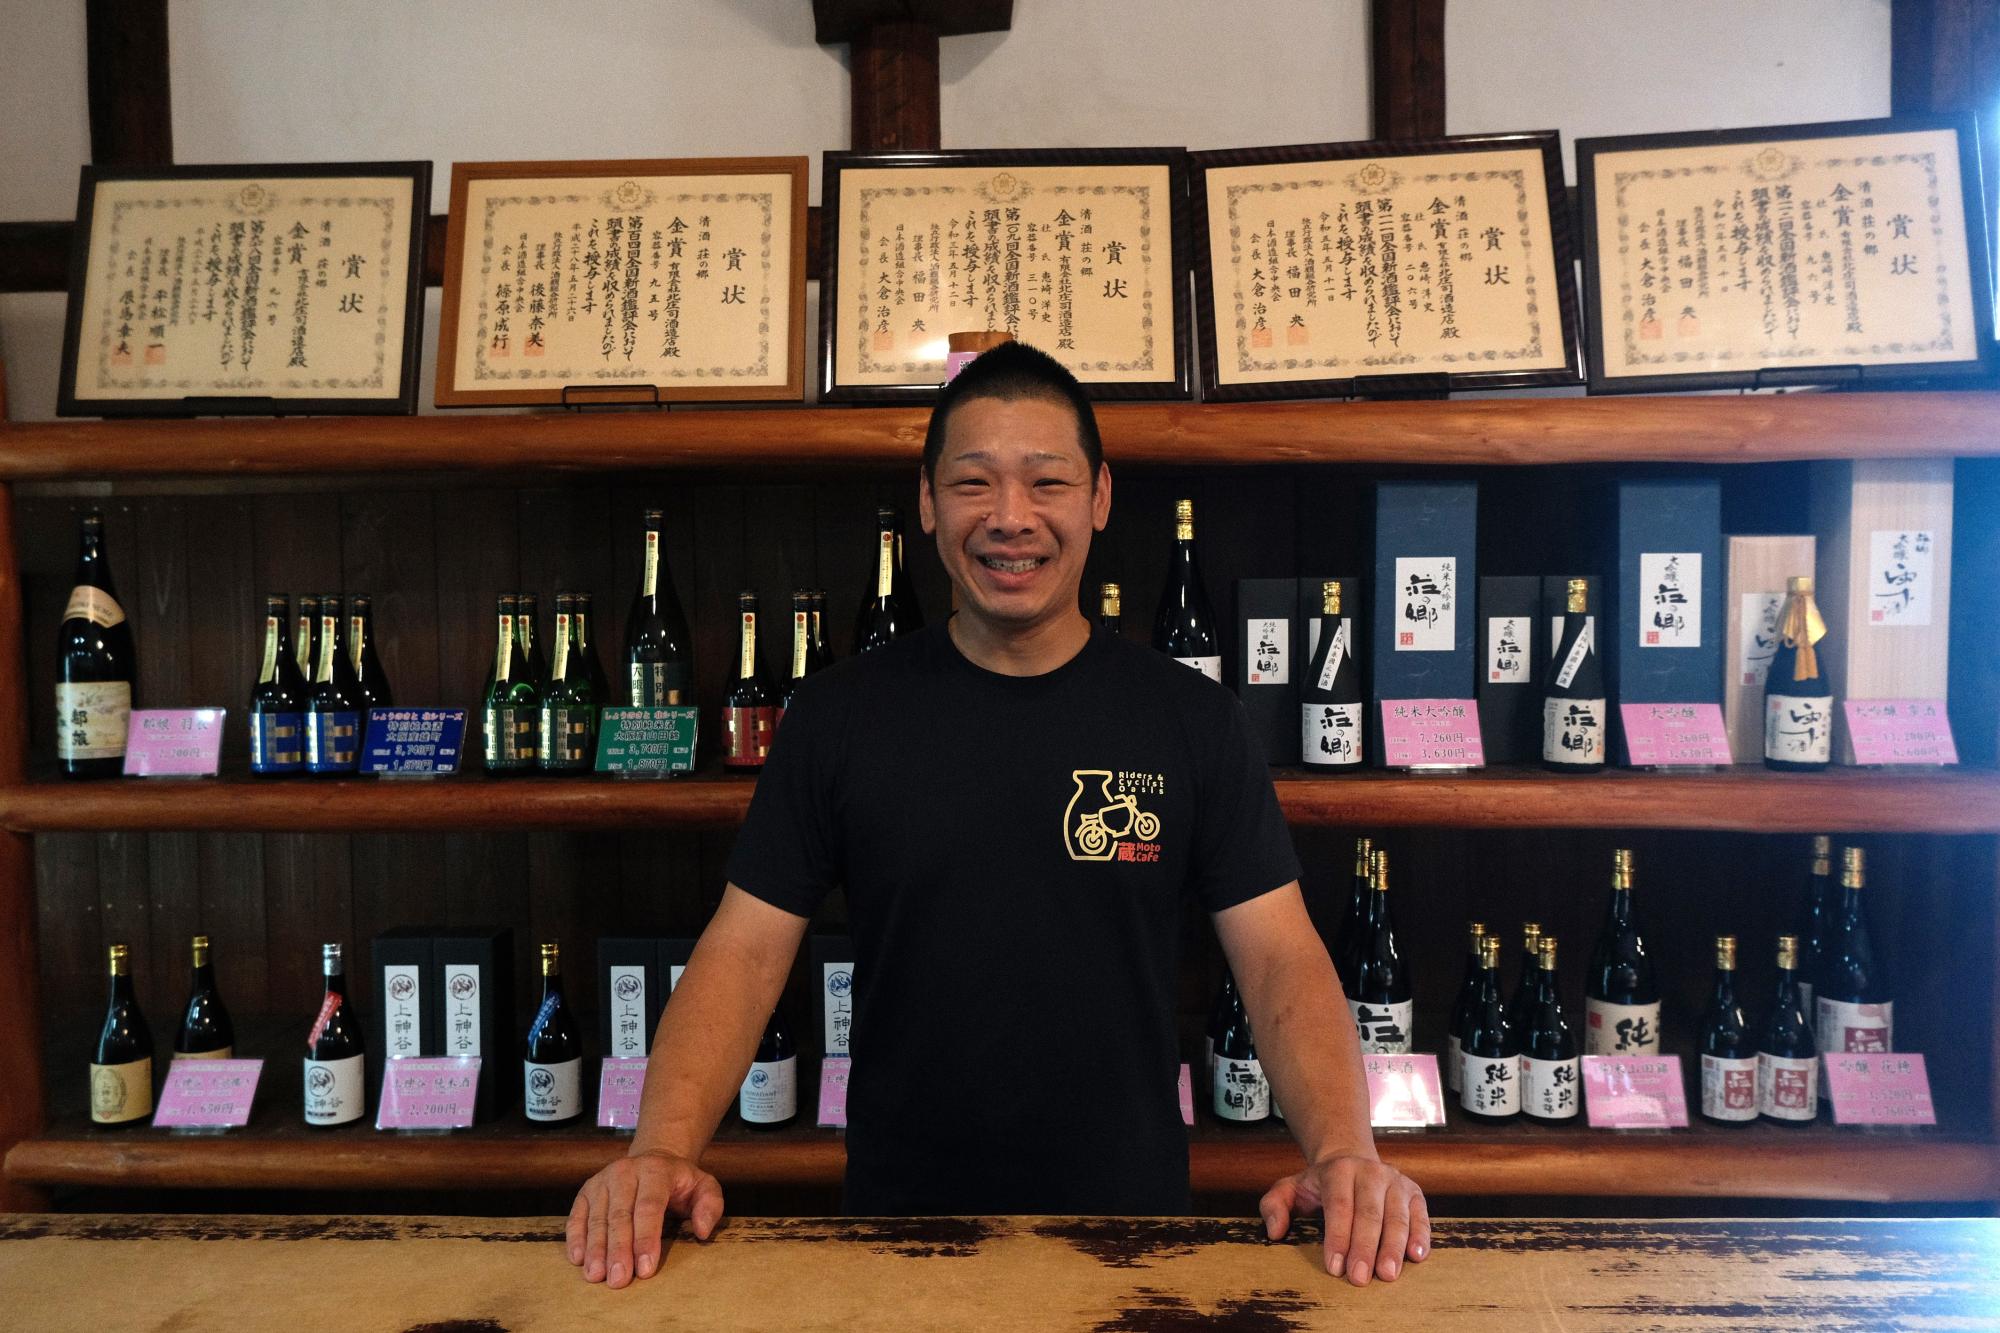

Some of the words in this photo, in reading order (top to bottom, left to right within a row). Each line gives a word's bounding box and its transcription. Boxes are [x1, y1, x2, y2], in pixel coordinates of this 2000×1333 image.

[1080, 208, 1093, 235] 清酒
[1427, 196, 1451, 240] 金賞
[1454, 195, 1468, 222] 清酒
[1830, 182, 1854, 227] 金賞
[288, 222, 310, 265] 金賞
[651, 230, 662, 269] 容器番号
[666, 217, 689, 258] 金賞
[698, 216, 712, 241] 清酒
[879, 236, 890, 263] 会長
[912, 234, 924, 262] 理事長
[1027, 222, 1038, 262] 容器番号
[1053, 209, 1076, 251] 金賞
[1250, 233, 1262, 260] 会長
[1285, 230, 1297, 258] 理事長
[1457, 227, 1473, 263] 荘の郷
[1730, 190, 1752, 291] これを授与します
[1886, 213, 1919, 275] 賞状
[500, 244, 512, 272] 会長
[535, 243, 547, 271] 理事長
[581, 218, 602, 314] これを授与します
[696, 248, 710, 280] 荘の郷
[895, 223, 905, 305] 日本酒造組合中央会
[961, 210, 981, 307] これを授与します
[983, 209, 1001, 333] 頭書の成績を収められまし
[1080, 242, 1093, 278] 荘の郷
[1102, 240, 1128, 299] 賞状
[1266, 220, 1282, 302] 日本酒造組合中央会
[1335, 202, 1357, 302] これを授与します
[1480, 227, 1511, 286] 賞状
[339, 255, 365, 313] 賞状
[601, 218, 624, 362] 頭書の成績を収められましたので
[620, 216, 644, 362] 第百四回全国新酒鑑評会において
[721, 247, 747, 305] 賞状
[1354, 200, 1382, 349] 頭書の成績を収められましたので
[647, 279, 661, 321] 九五号
[1394, 705, 1466, 718] 純米大吟醸
[1420, 733, 1464, 744] 7,260円
[1422, 748, 1466, 759] 3,630円
[1118, 771, 1153, 781] Riders
[1118, 778, 1164, 788] Cyclist
[1118, 785, 1164, 795] Oasis
[1117, 842, 1136, 863] 蔵
[1137, 843, 1161, 852] Moto
[1137, 852, 1160, 862] Cafe
[393, 1003, 412, 1050] 上神谷
[454, 1003, 473, 1050] 上神谷
[619, 1003, 638, 1050] 上神谷
[1485, 1063, 1512, 1107] 純米
[1553, 1064, 1576, 1110] 純米
